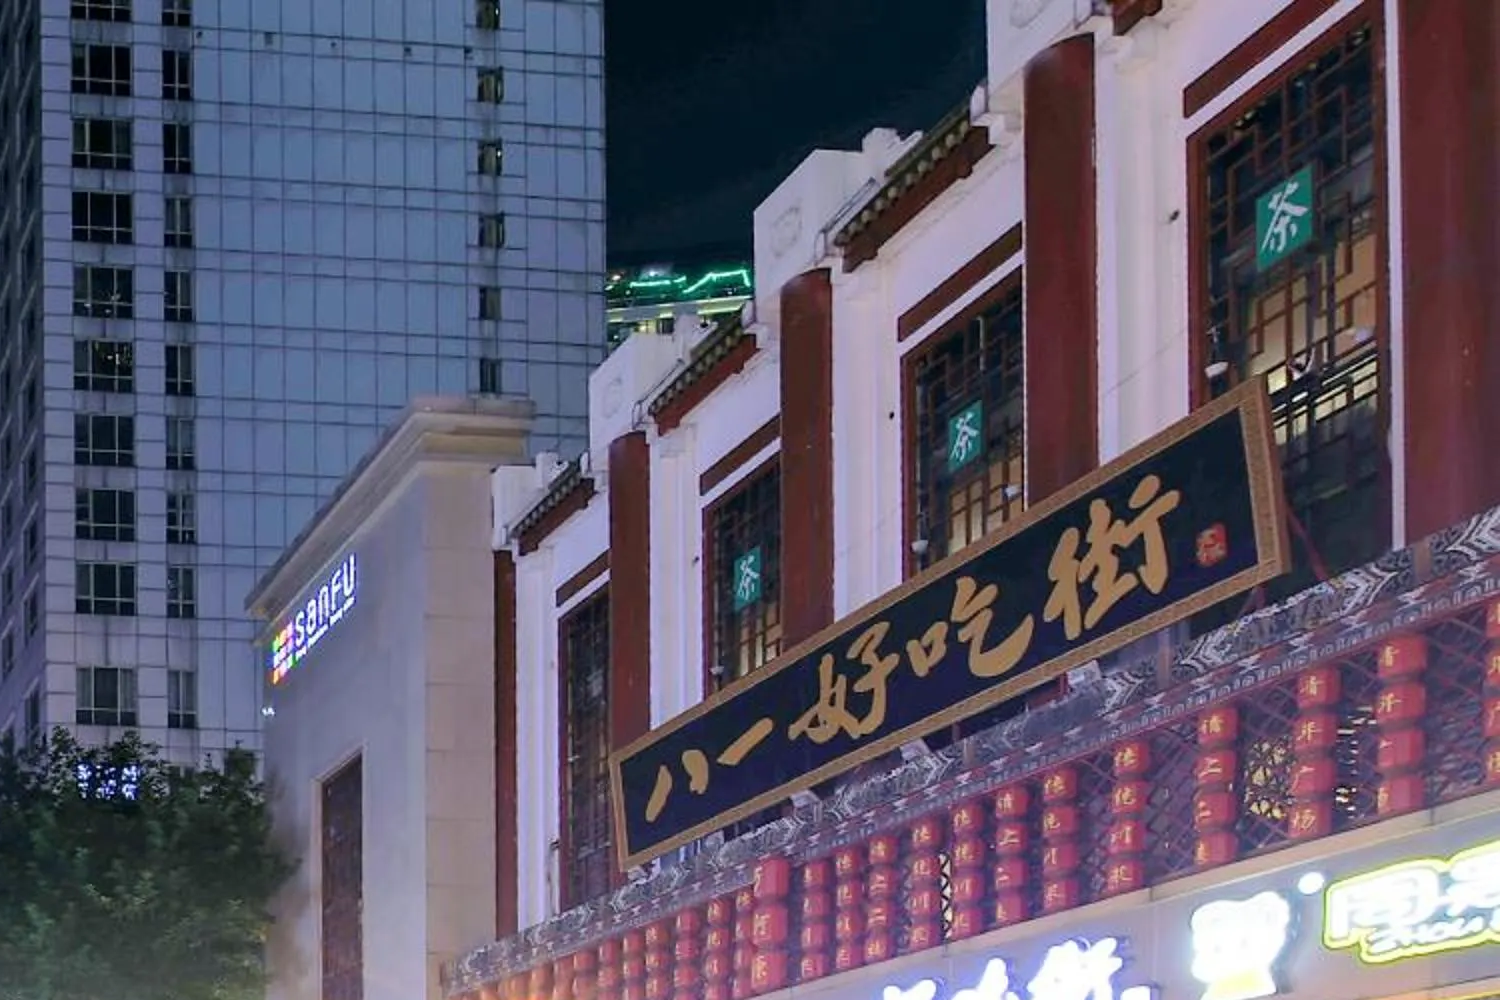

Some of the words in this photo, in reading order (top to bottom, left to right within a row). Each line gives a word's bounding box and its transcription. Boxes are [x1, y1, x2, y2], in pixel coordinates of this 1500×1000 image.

[1262, 180, 1308, 255] 茶
[949, 411, 980, 461] 茶
[736, 556, 760, 602] 茶
[644, 473, 1182, 823] 八一好吃街
